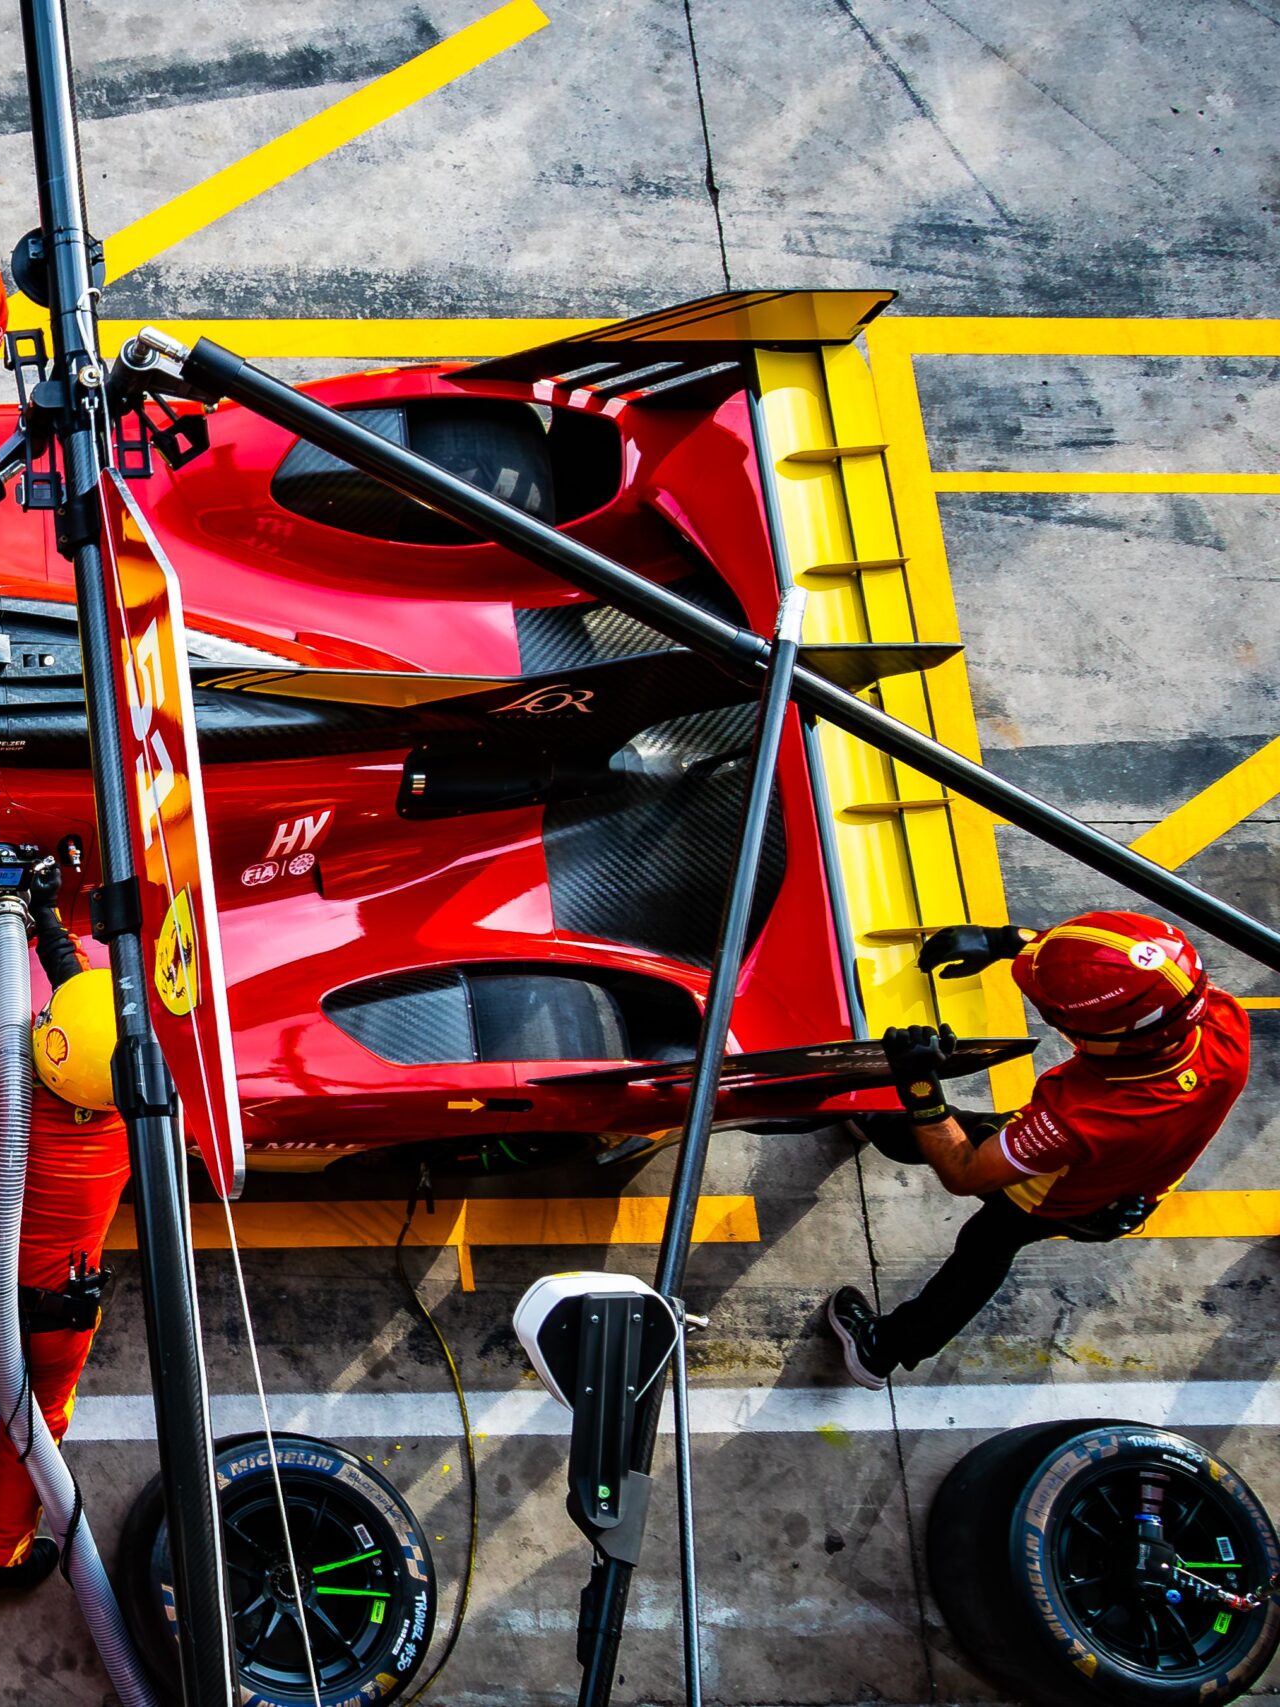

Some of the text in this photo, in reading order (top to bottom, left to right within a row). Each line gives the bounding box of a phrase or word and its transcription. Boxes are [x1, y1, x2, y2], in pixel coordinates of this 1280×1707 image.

[125, 616, 175, 852] 51
[265, 810, 331, 858] HY
[1138, 945, 1159, 967] 14
[1100, 987, 1126, 1001] MILLE
[228, 1451, 334, 1477] MICHELIN
[1025, 1532, 1070, 1641] MICHELIN
[411, 1590, 428, 1641] TRAVEL
[397, 1642, 417, 1672] #50
